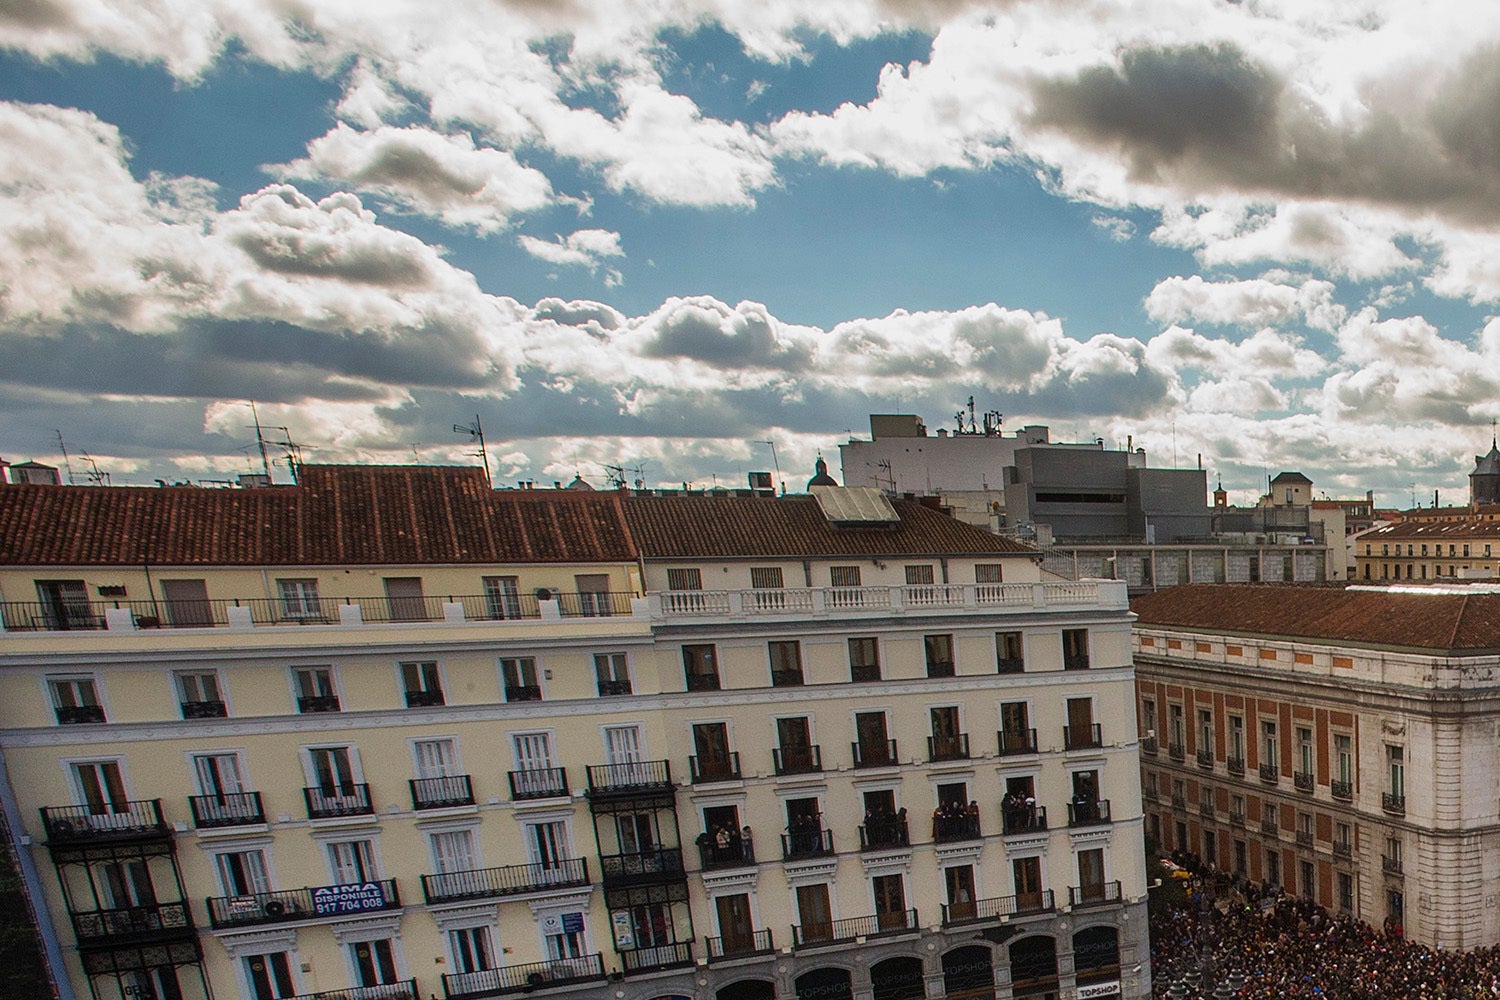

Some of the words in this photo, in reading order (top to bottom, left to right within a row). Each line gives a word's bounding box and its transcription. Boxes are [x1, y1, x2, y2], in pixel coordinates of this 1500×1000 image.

[314, 882, 380, 896] AIMA
[315, 889, 382, 904] DISPONIBLE
[316, 903, 337, 914] 917
[340, 900, 361, 912] 704
[363, 897, 384, 909] 008
[1079, 985, 1119, 998] TOPSHOP
